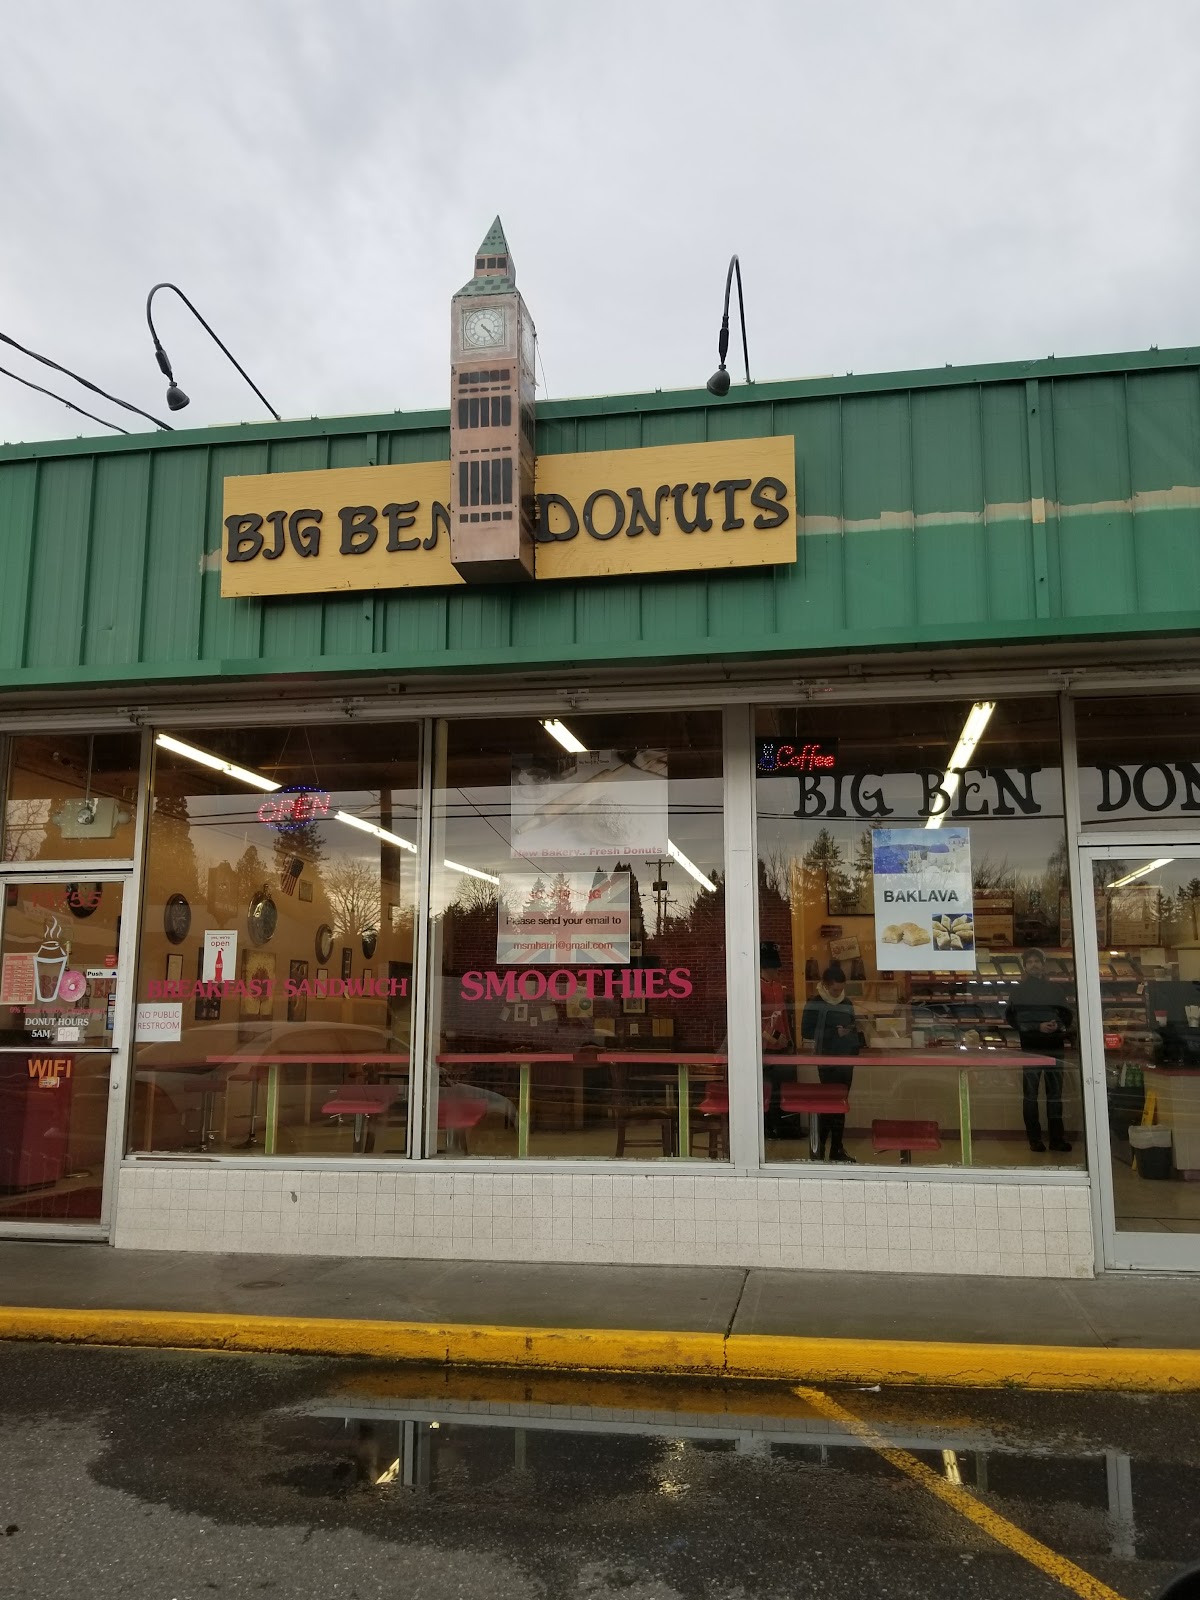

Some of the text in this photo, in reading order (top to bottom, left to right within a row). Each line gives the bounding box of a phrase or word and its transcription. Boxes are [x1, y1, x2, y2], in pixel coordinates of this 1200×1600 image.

[224, 507, 324, 563] BIG
[533, 476, 790, 543] DONUTS
[776, 744, 834, 771] Coffee
[794, 771, 894, 818] BIG
[915, 765, 1041, 817] BEN
[257, 793, 331, 822] OPEN
[588, 845, 620, 856] Fresh
[622, 845, 663, 855] Donuts
[883, 889, 960, 903] BAKLAVA
[538, 916, 561, 925] send
[562, 918, 583, 928] your
[585, 915, 610, 925] email
[611, 916, 622, 925] to
[210, 940, 231, 948] open
[147, 977, 408, 999] BREAKFAST SANDWICH
[460, 967, 694, 1001] SMOOTHIES
[25, 1017, 90, 1026] DONUT HOURS
[139, 1010, 181, 1019] NO PUBLIC
[138, 1021, 181, 1031] RESTROOM
[31, 1029, 50, 1039] 5AM
[28, 1059, 72, 1079] WIFI
